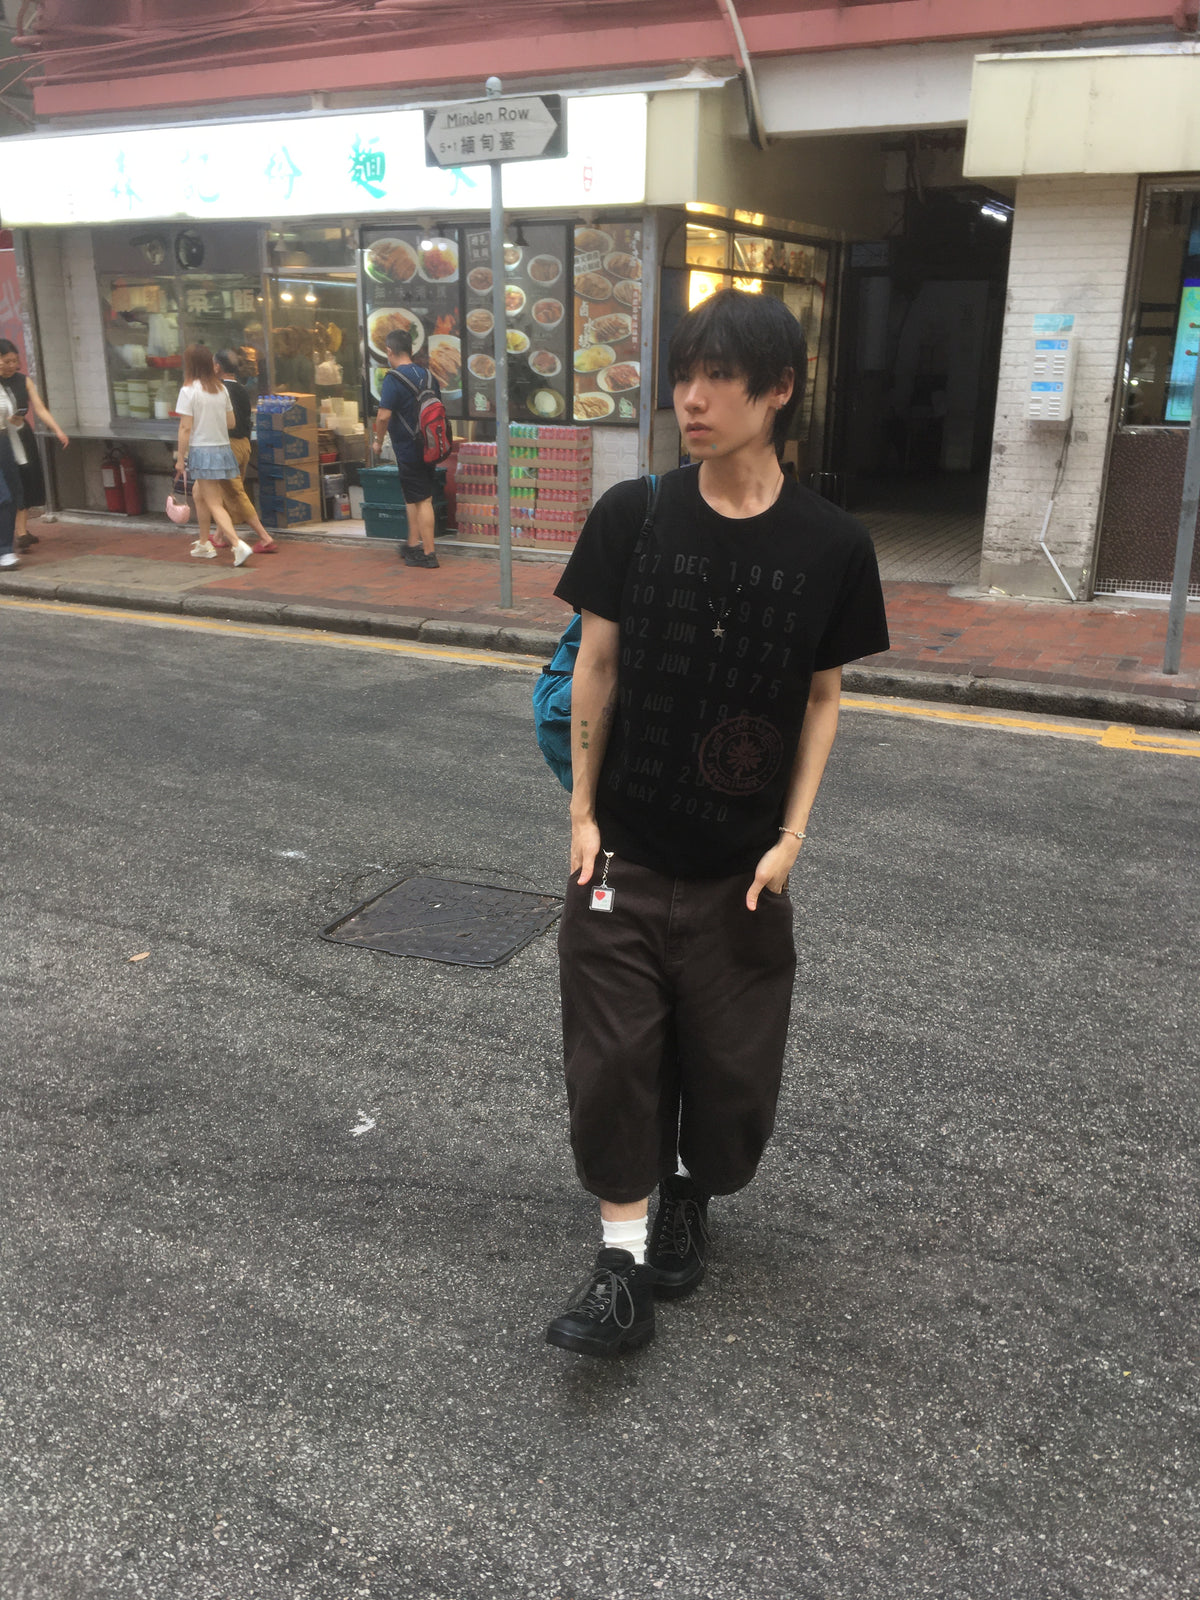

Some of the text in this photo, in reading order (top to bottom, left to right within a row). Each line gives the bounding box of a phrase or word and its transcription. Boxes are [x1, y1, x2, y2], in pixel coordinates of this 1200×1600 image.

[446, 106, 530, 128] Minden Row
[460, 131, 516, 155] 緬甸臺
[636, 553, 807, 596] 07 DEC 1962
[631, 583, 797, 634] 10 JUL 1965
[624, 615, 650, 639] 02
[661, 620, 698, 645] JUN
[621, 647, 783, 700] 02 JUN 1975
[641, 693, 675, 714] AUG
[639, 722, 671, 747] JUL
[631, 757, 664, 779] JAN
[626, 782, 658, 803] MAY
[668, 792, 730, 823] 2020
